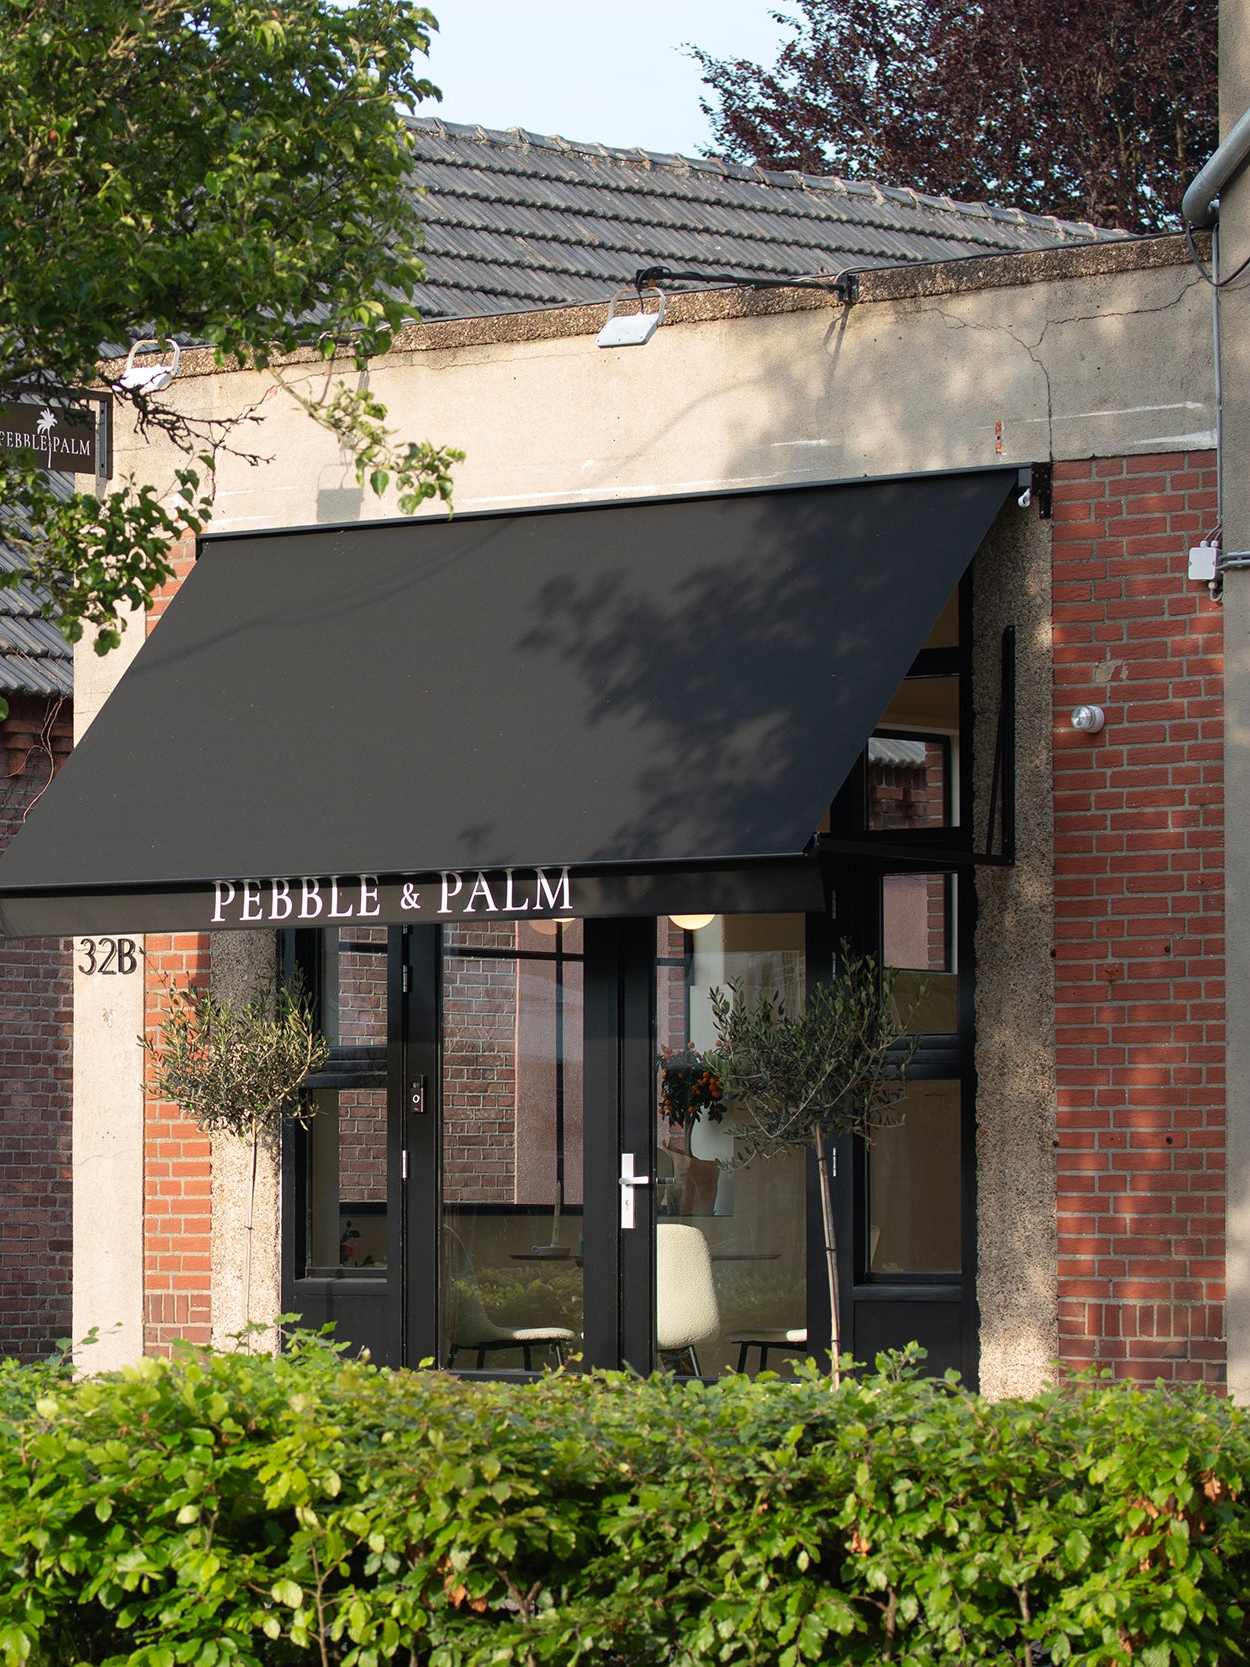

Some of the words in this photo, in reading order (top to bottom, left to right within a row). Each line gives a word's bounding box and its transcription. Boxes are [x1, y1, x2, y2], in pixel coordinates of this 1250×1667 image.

[53, 436, 91, 456] PALM
[211, 874, 381, 922] PEBBLE
[400, 882, 421, 910] &
[437, 866, 573, 914] PALM
[78, 938, 137, 975] 32B
